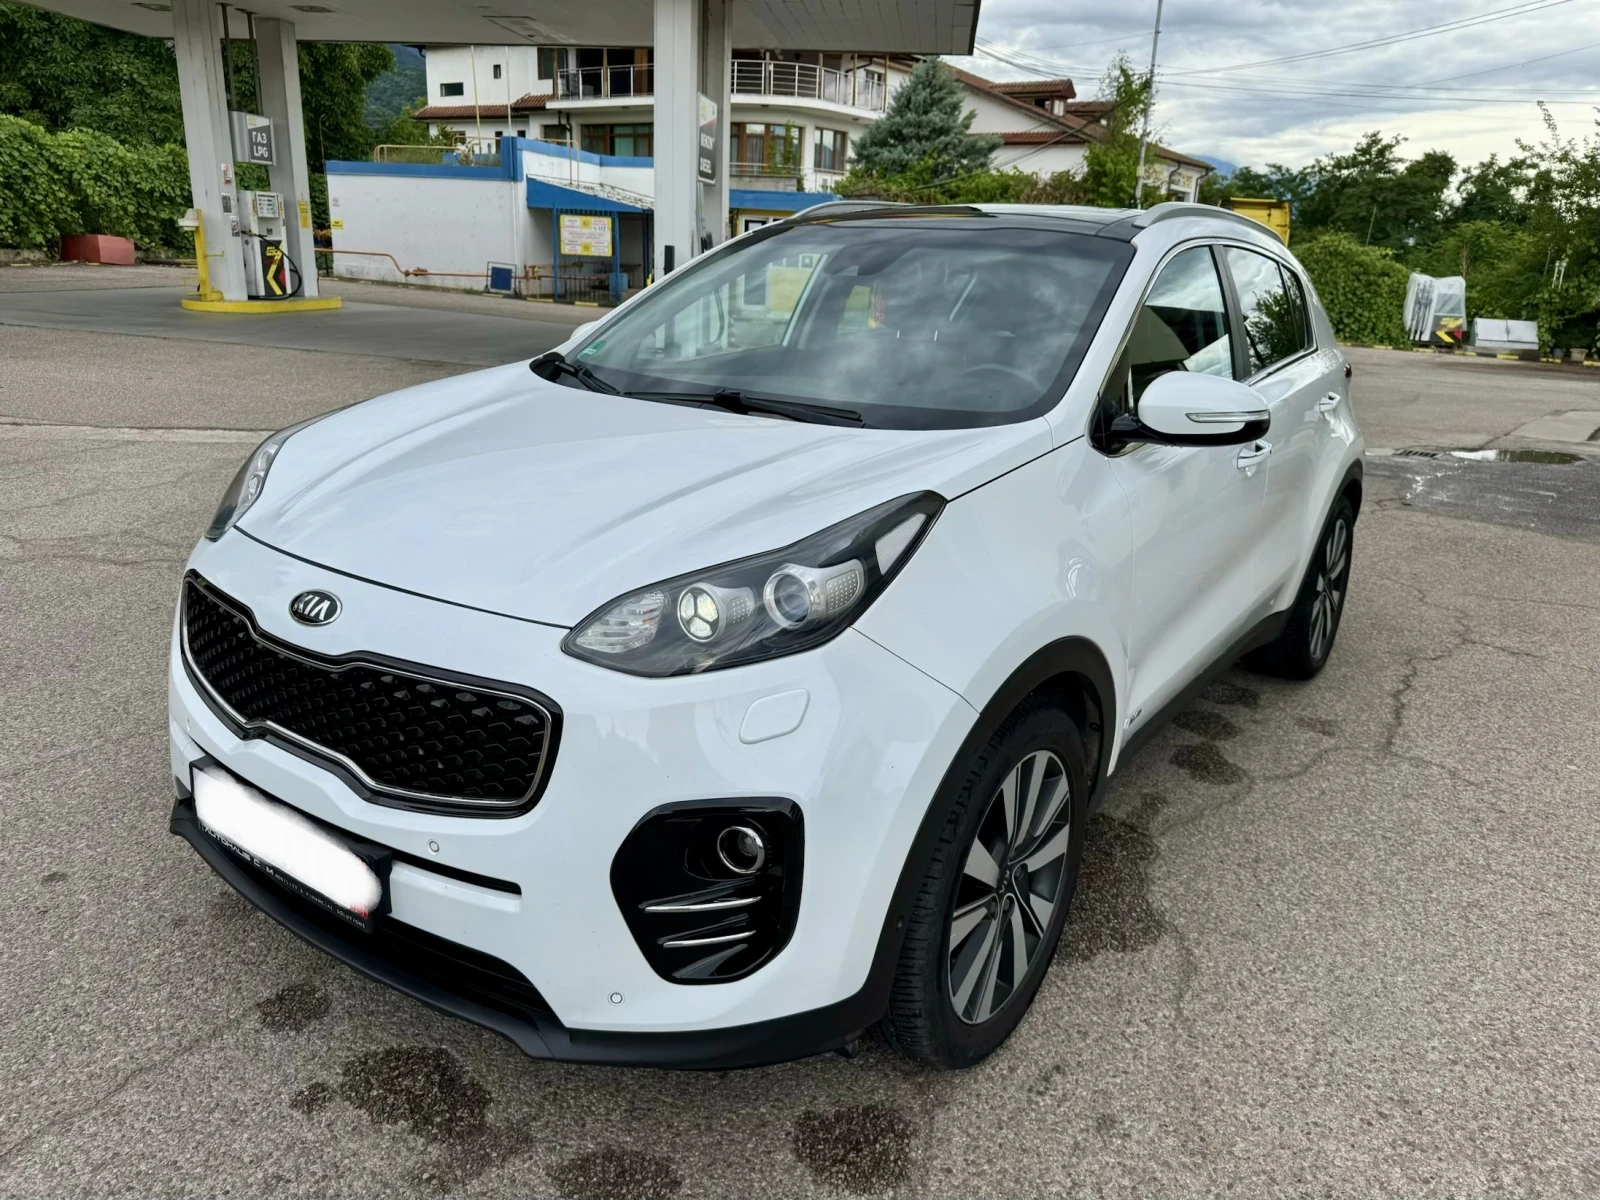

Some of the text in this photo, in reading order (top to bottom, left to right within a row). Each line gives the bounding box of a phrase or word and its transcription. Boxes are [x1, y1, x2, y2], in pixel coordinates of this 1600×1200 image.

[252, 131, 267, 144] ГАЗ
[253, 145, 269, 158] LPG
[292, 593, 331, 621] KIA
